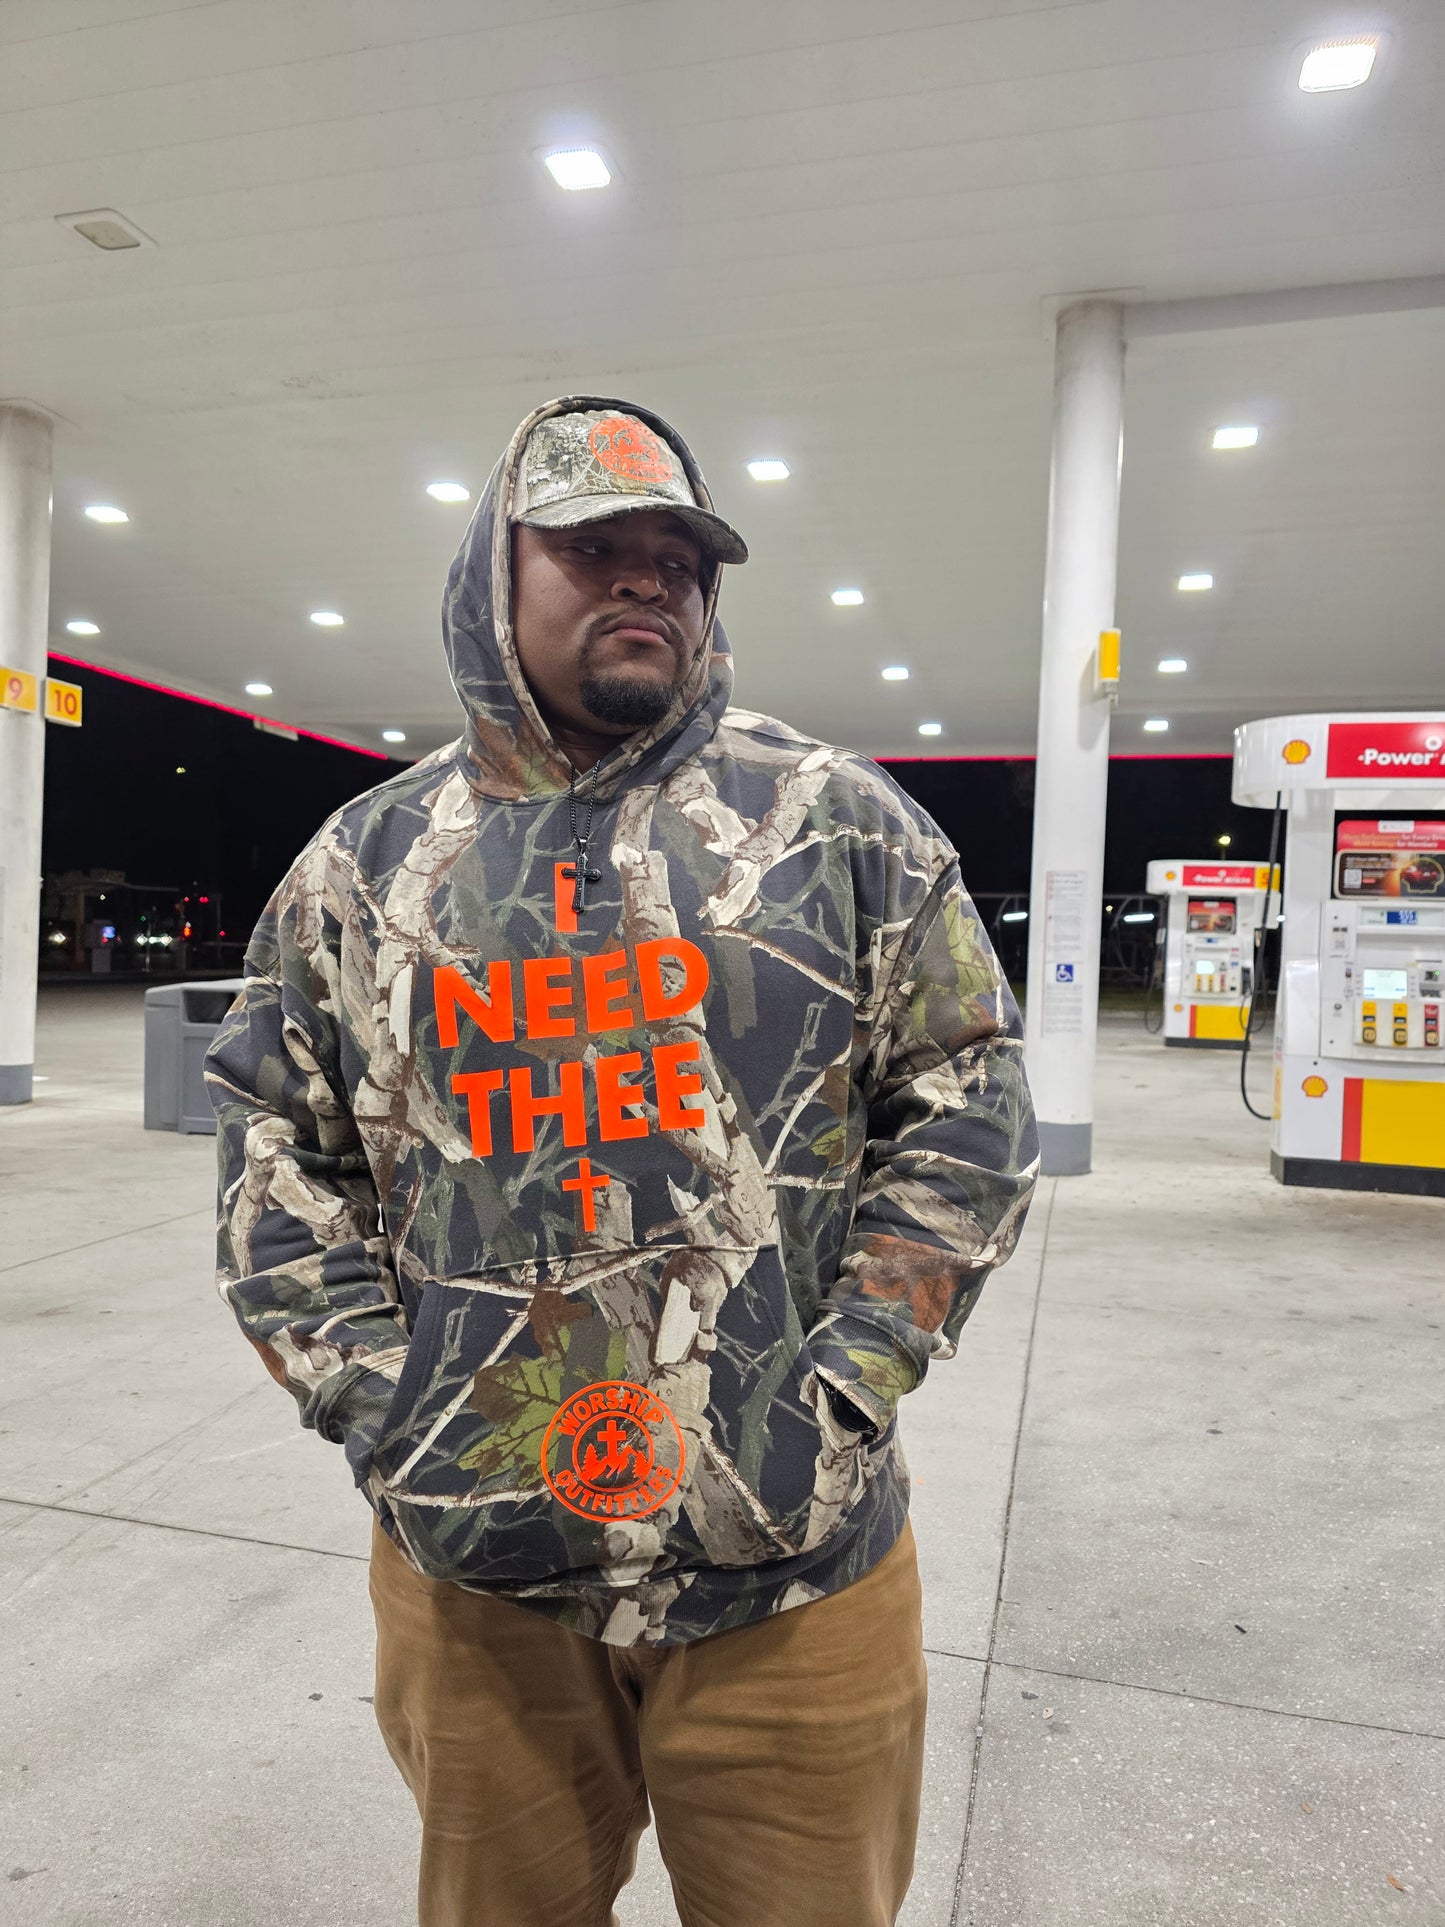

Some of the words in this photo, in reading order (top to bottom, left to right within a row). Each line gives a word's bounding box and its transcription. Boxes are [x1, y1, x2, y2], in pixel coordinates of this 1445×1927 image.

[8, 677, 23, 701] 9
[55, 688, 77, 716] 10
[554, 862, 579, 932] I
[433, 936, 710, 1049] NEED
[451, 1041, 706, 1158] THEE
[556, 1388, 664, 1437] WORSHIP
[555, 1465, 673, 1515] OUTFITTERS
